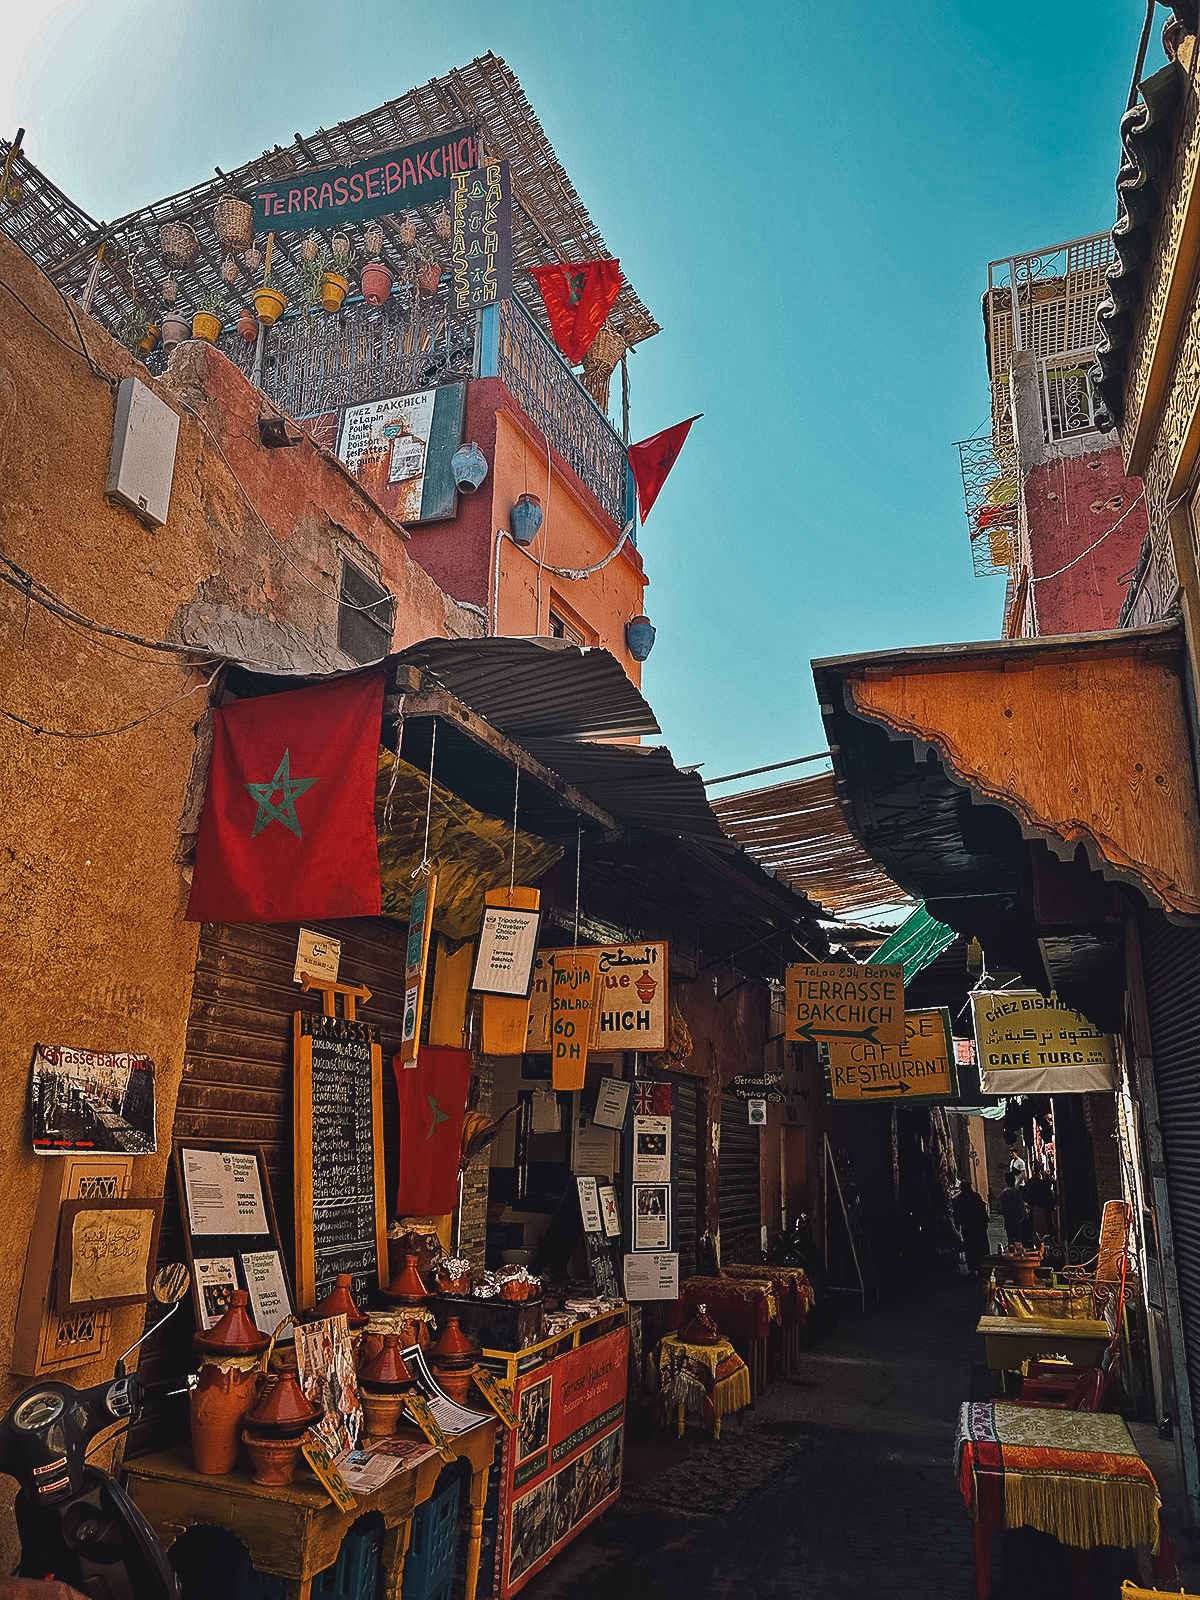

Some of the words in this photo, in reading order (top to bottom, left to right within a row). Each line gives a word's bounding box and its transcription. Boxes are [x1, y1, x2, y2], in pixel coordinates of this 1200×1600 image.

[384, 136, 479, 194] BAKCHICH
[451, 171, 470, 309] TERRASSE
[482, 164, 502, 300] BAKCHICH
[348, 407, 371, 418] CHEZ
[376, 395, 427, 413] BAKCHICH
[349, 424, 373, 433] Poulet
[360, 414, 384, 424] Lapin
[347, 437, 379, 450] Poisson
[357, 445, 388, 456] Pattes
[497, 916, 530, 926] Tripadvisor
[495, 928, 517, 936] Choice
[598, 946, 659, 972] السطح
[839, 967, 859, 980] 294
[794, 980, 896, 1002] TERRASSE
[601, 1010, 650, 1032] HICH
[797, 1003, 892, 1024] BAKCHICH
[985, 1001, 1020, 1023] CHEZ
[553, 1017, 575, 1038] 60
[1005, 1028, 1053, 1046] تركية
[556, 1041, 581, 1060] DH
[988, 1050, 1032, 1066] CAFÉ
[1037, 1051, 1084, 1064] TURC
[834, 1057, 948, 1088] RESTAURANT
[324, 1473, 342, 1492] 40
